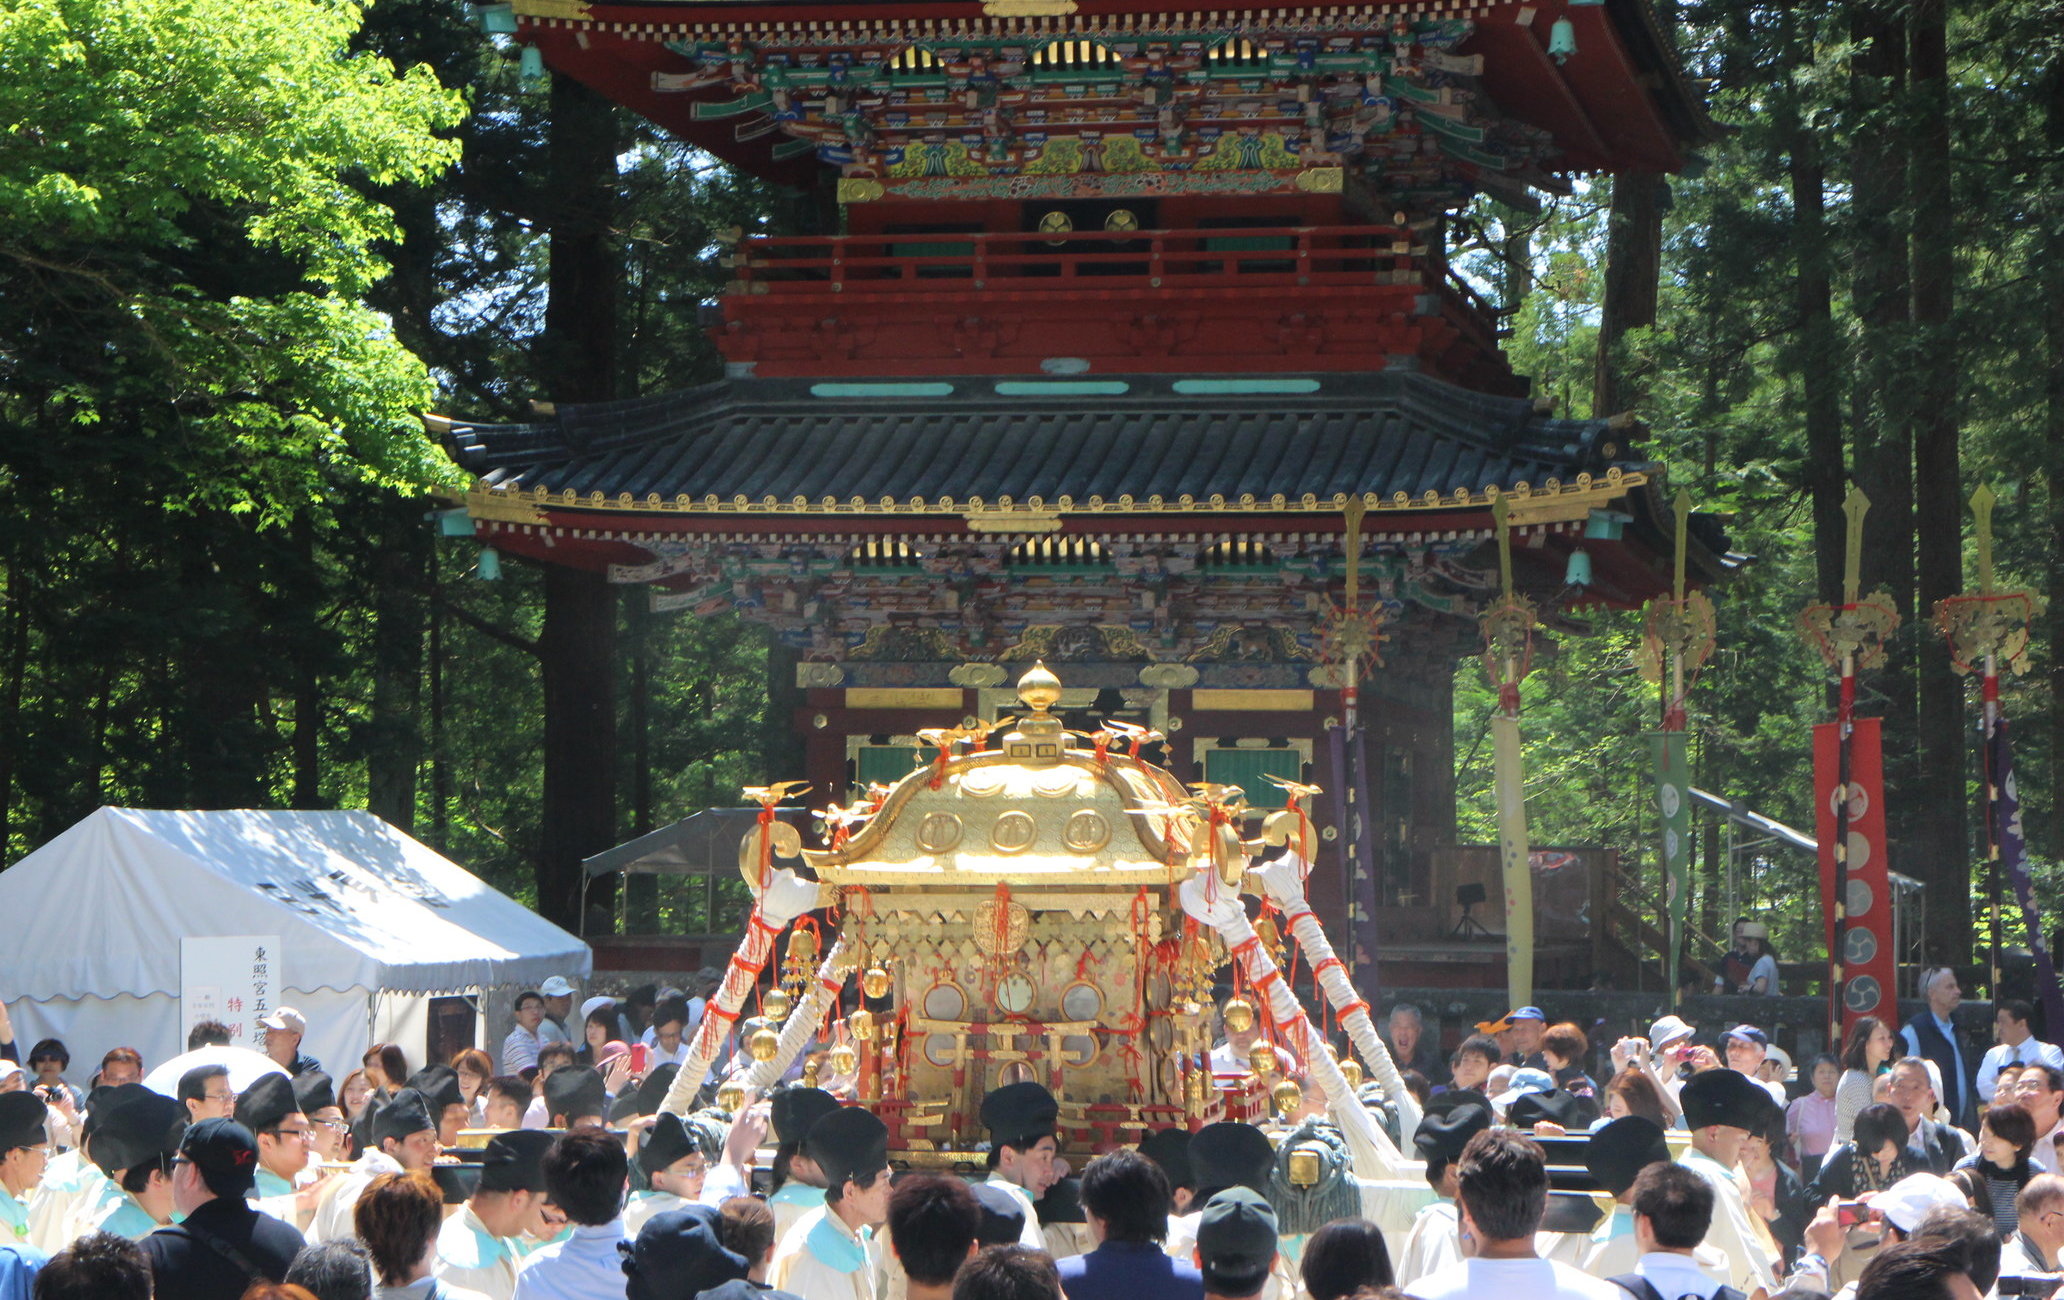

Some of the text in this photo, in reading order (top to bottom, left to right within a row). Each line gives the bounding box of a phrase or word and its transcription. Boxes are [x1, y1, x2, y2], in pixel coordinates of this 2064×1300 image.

[252, 946, 269, 1056] 東照宮五重塔
